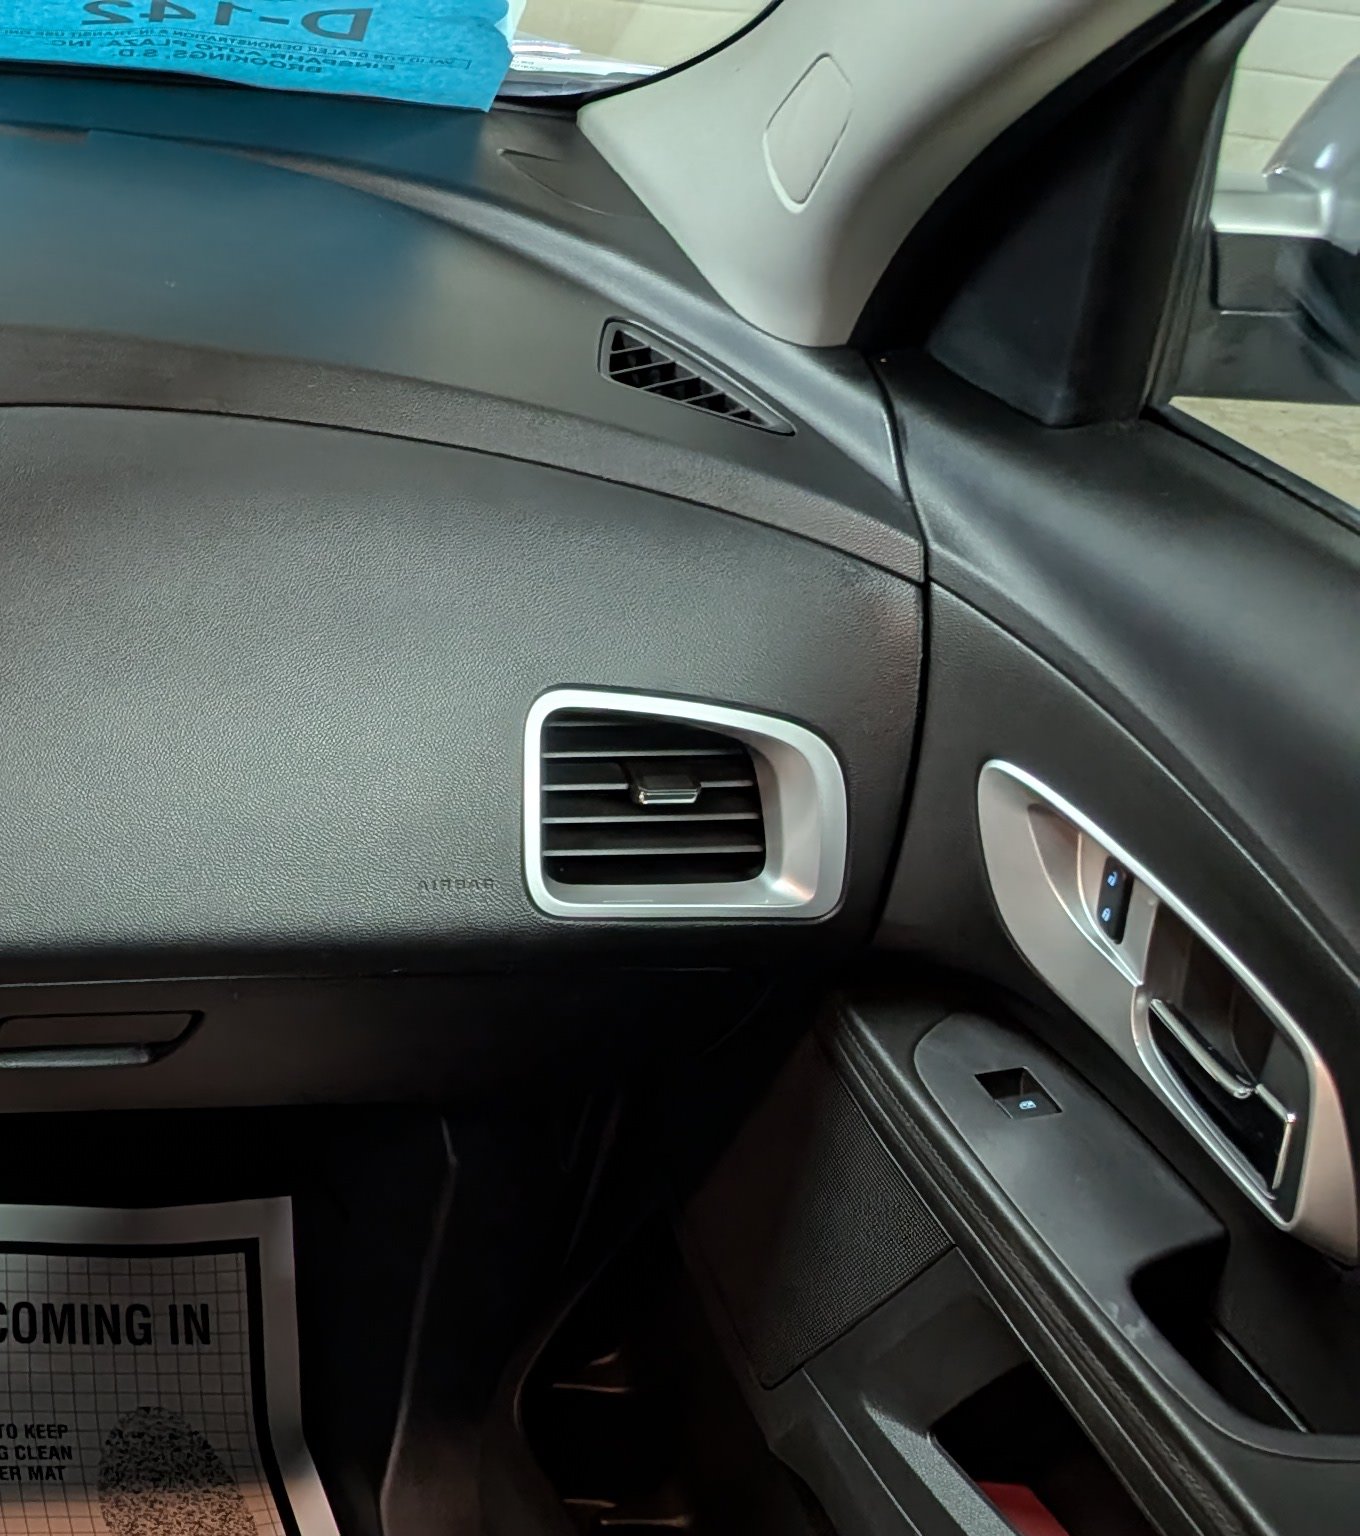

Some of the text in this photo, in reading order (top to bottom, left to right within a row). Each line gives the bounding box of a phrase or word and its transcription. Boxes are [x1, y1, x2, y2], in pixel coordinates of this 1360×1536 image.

[168, 1303, 212, 1345] IN
[24, 1423, 69, 1439] KEEP
[14, 1445, 73, 1461] CLEAN
[29, 1466, 66, 1481] MAT
